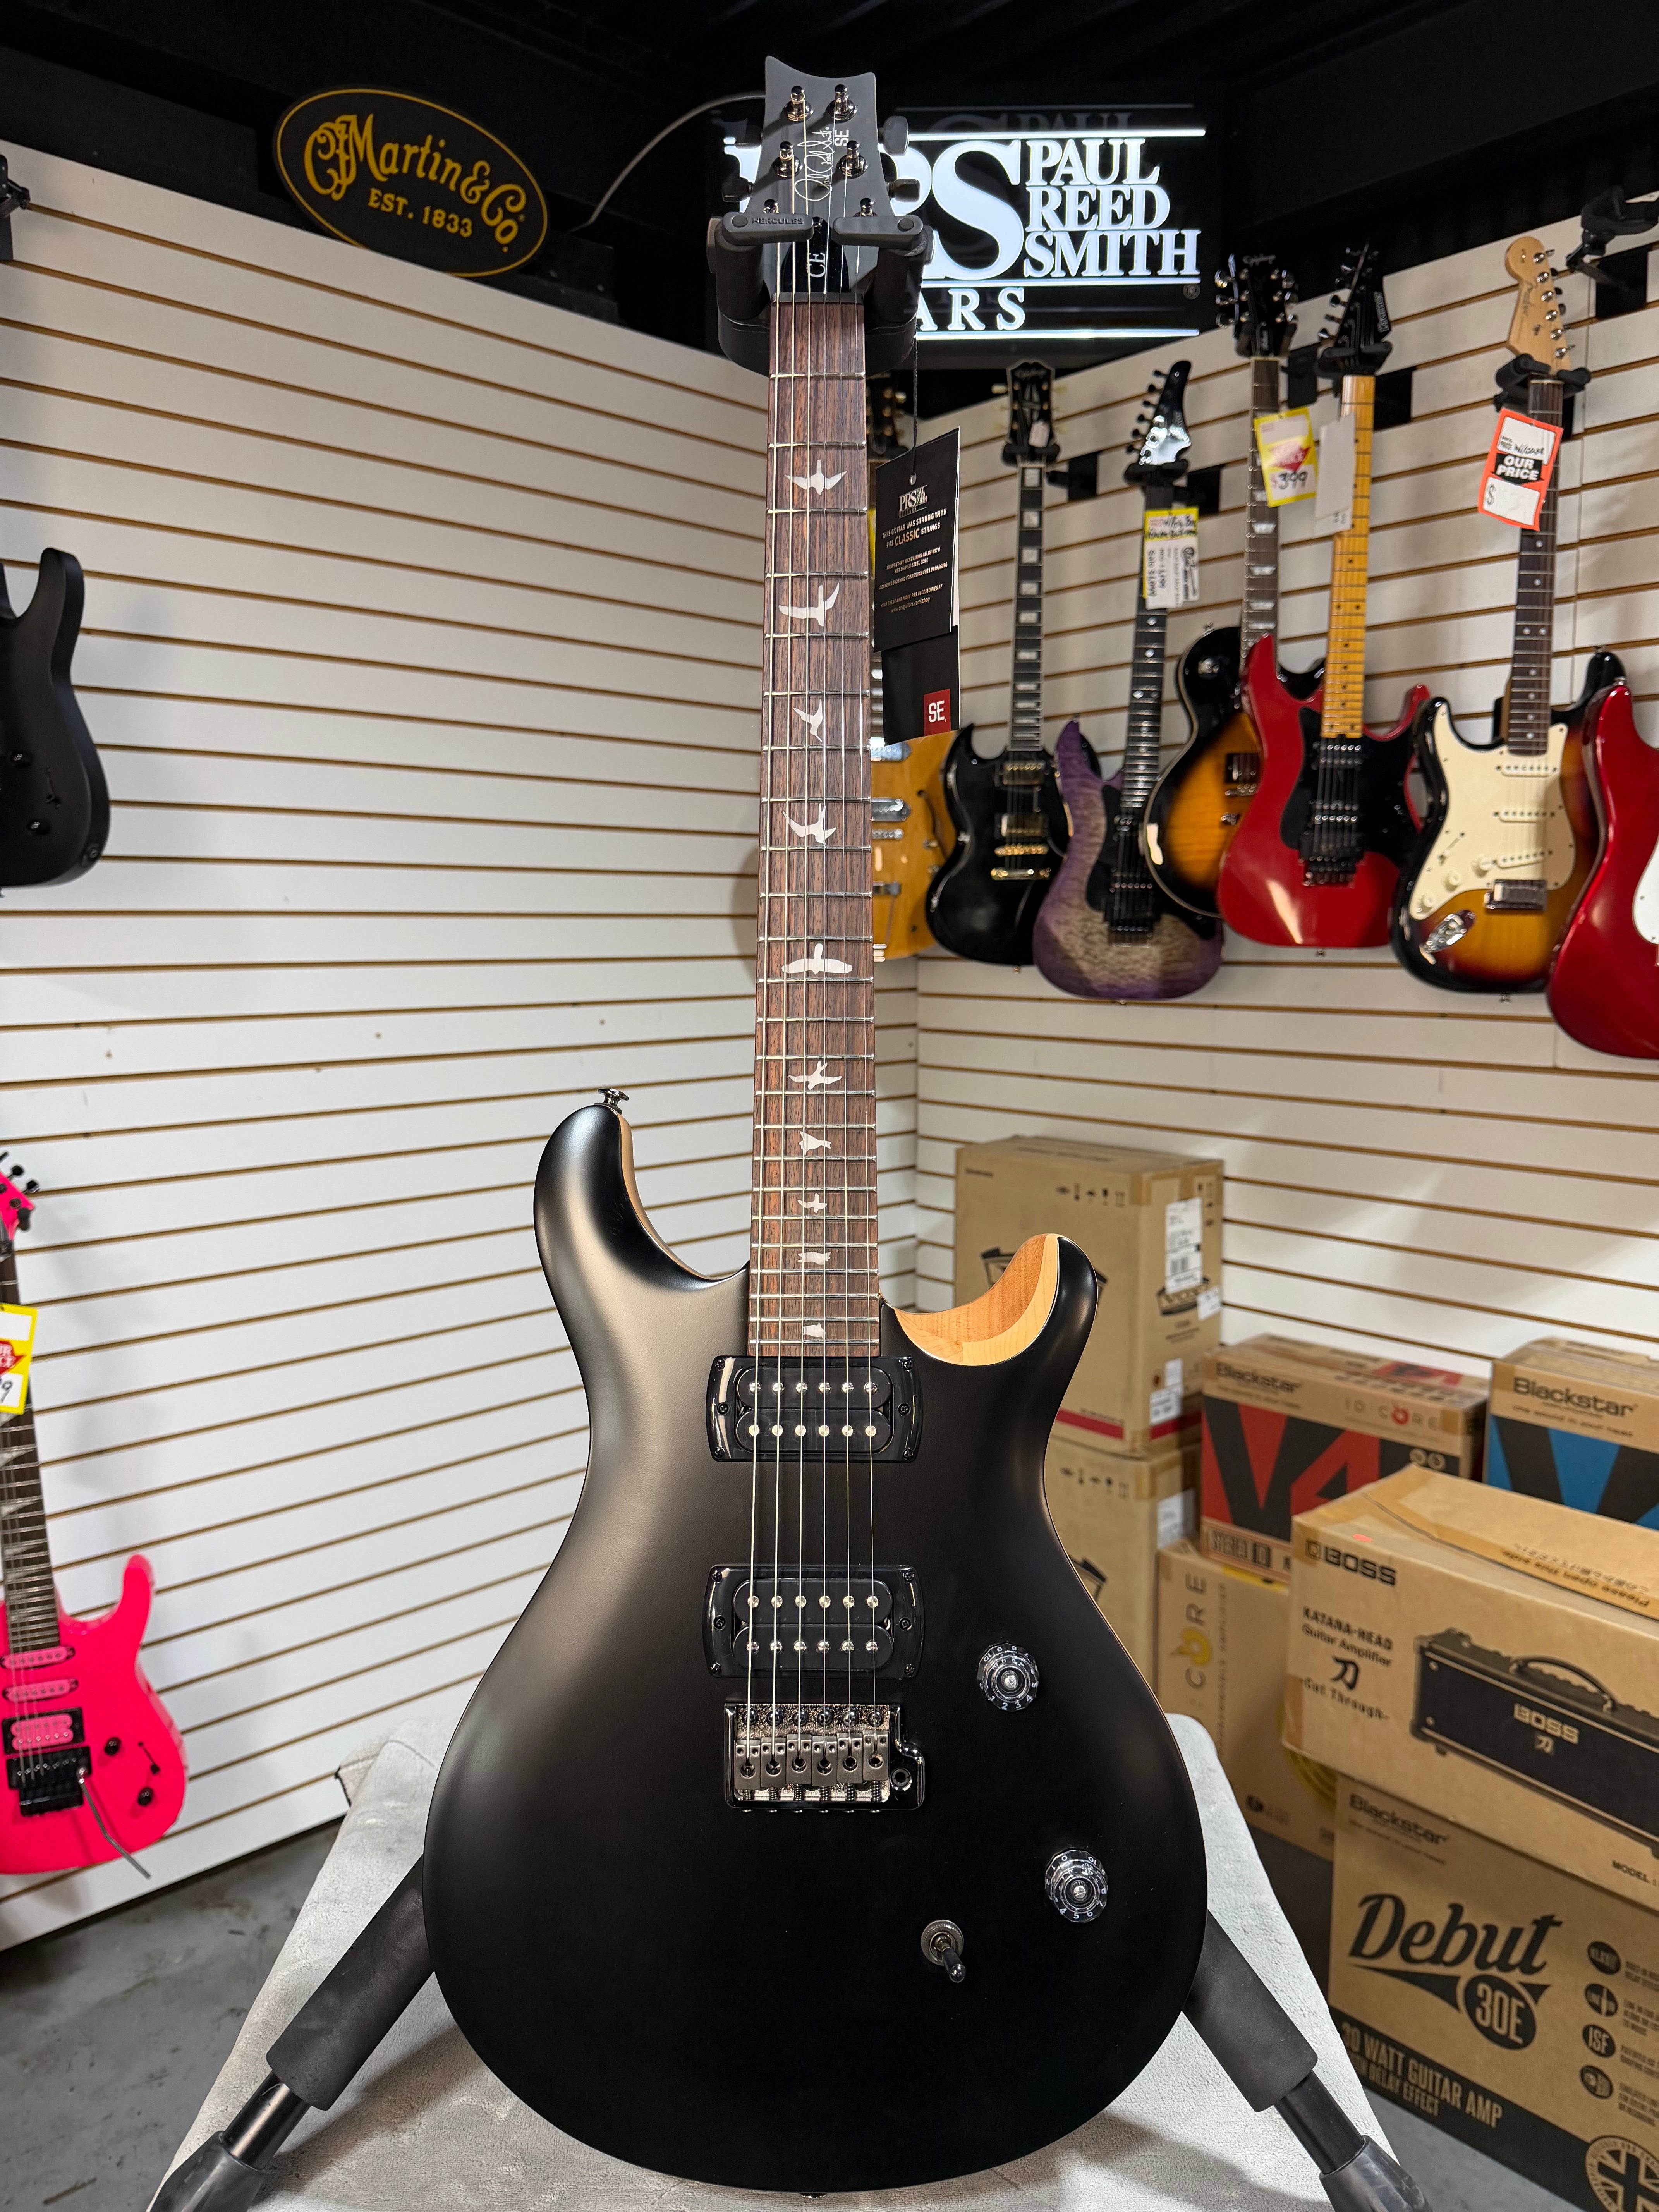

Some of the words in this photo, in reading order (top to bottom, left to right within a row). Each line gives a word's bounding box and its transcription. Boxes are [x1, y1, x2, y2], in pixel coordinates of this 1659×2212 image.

[834, 129, 849, 146] SE
[1026, 138, 1161, 187] PAUL
[368, 188, 414, 219] EST.
[423, 205, 473, 237] 1833
[1025, 185, 1170, 232] REED
[806, 253, 826, 278] CE
[1024, 230, 1202, 277] SMITH
[1496, 465, 1539, 480] PRICE
[1503, 455, 1534, 470] OUR
[899, 491, 917, 512] PRS
[882, 529, 891, 539] THIS
[891, 524, 905, 535] GUITAR
[906, 520, 915, 529] WAS
[916, 512, 934, 525] STRUNG
[935, 508, 947, 519] WITH
[895, 528, 920, 546] CLASSIC
[921, 522, 941, 535] STRINGS
[928, 699, 945, 723] SE
[1216, 1362, 1301, 1393] Blackstar
[1513, 1377, 1634, 1417] Blackstar
[1324, 1545, 1396, 1586] BOSS
[1302, 1606, 1393, 1651] KATANA-HEAD
[1302, 1623, 1336, 1645] Guitar
[1339, 1639, 1393, 1666] Amplifier
[1331, 1656, 1360, 1691] 刀
[1513, 1703, 1580, 1745] BOSS
[1349, 1793, 1449, 1845] Blackstar
[1612, 1859, 1651, 1884] MODEL
[1348, 1893, 1563, 1976] Debut
[1475, 1981, 1525, 2045] 30E
[1589, 2026, 1609, 2054] ISF
[1364, 2033, 1405, 2076] WATT
[1407, 2058, 1463, 2110] GUITAR
[1465, 2091, 1503, 2128] AMP
